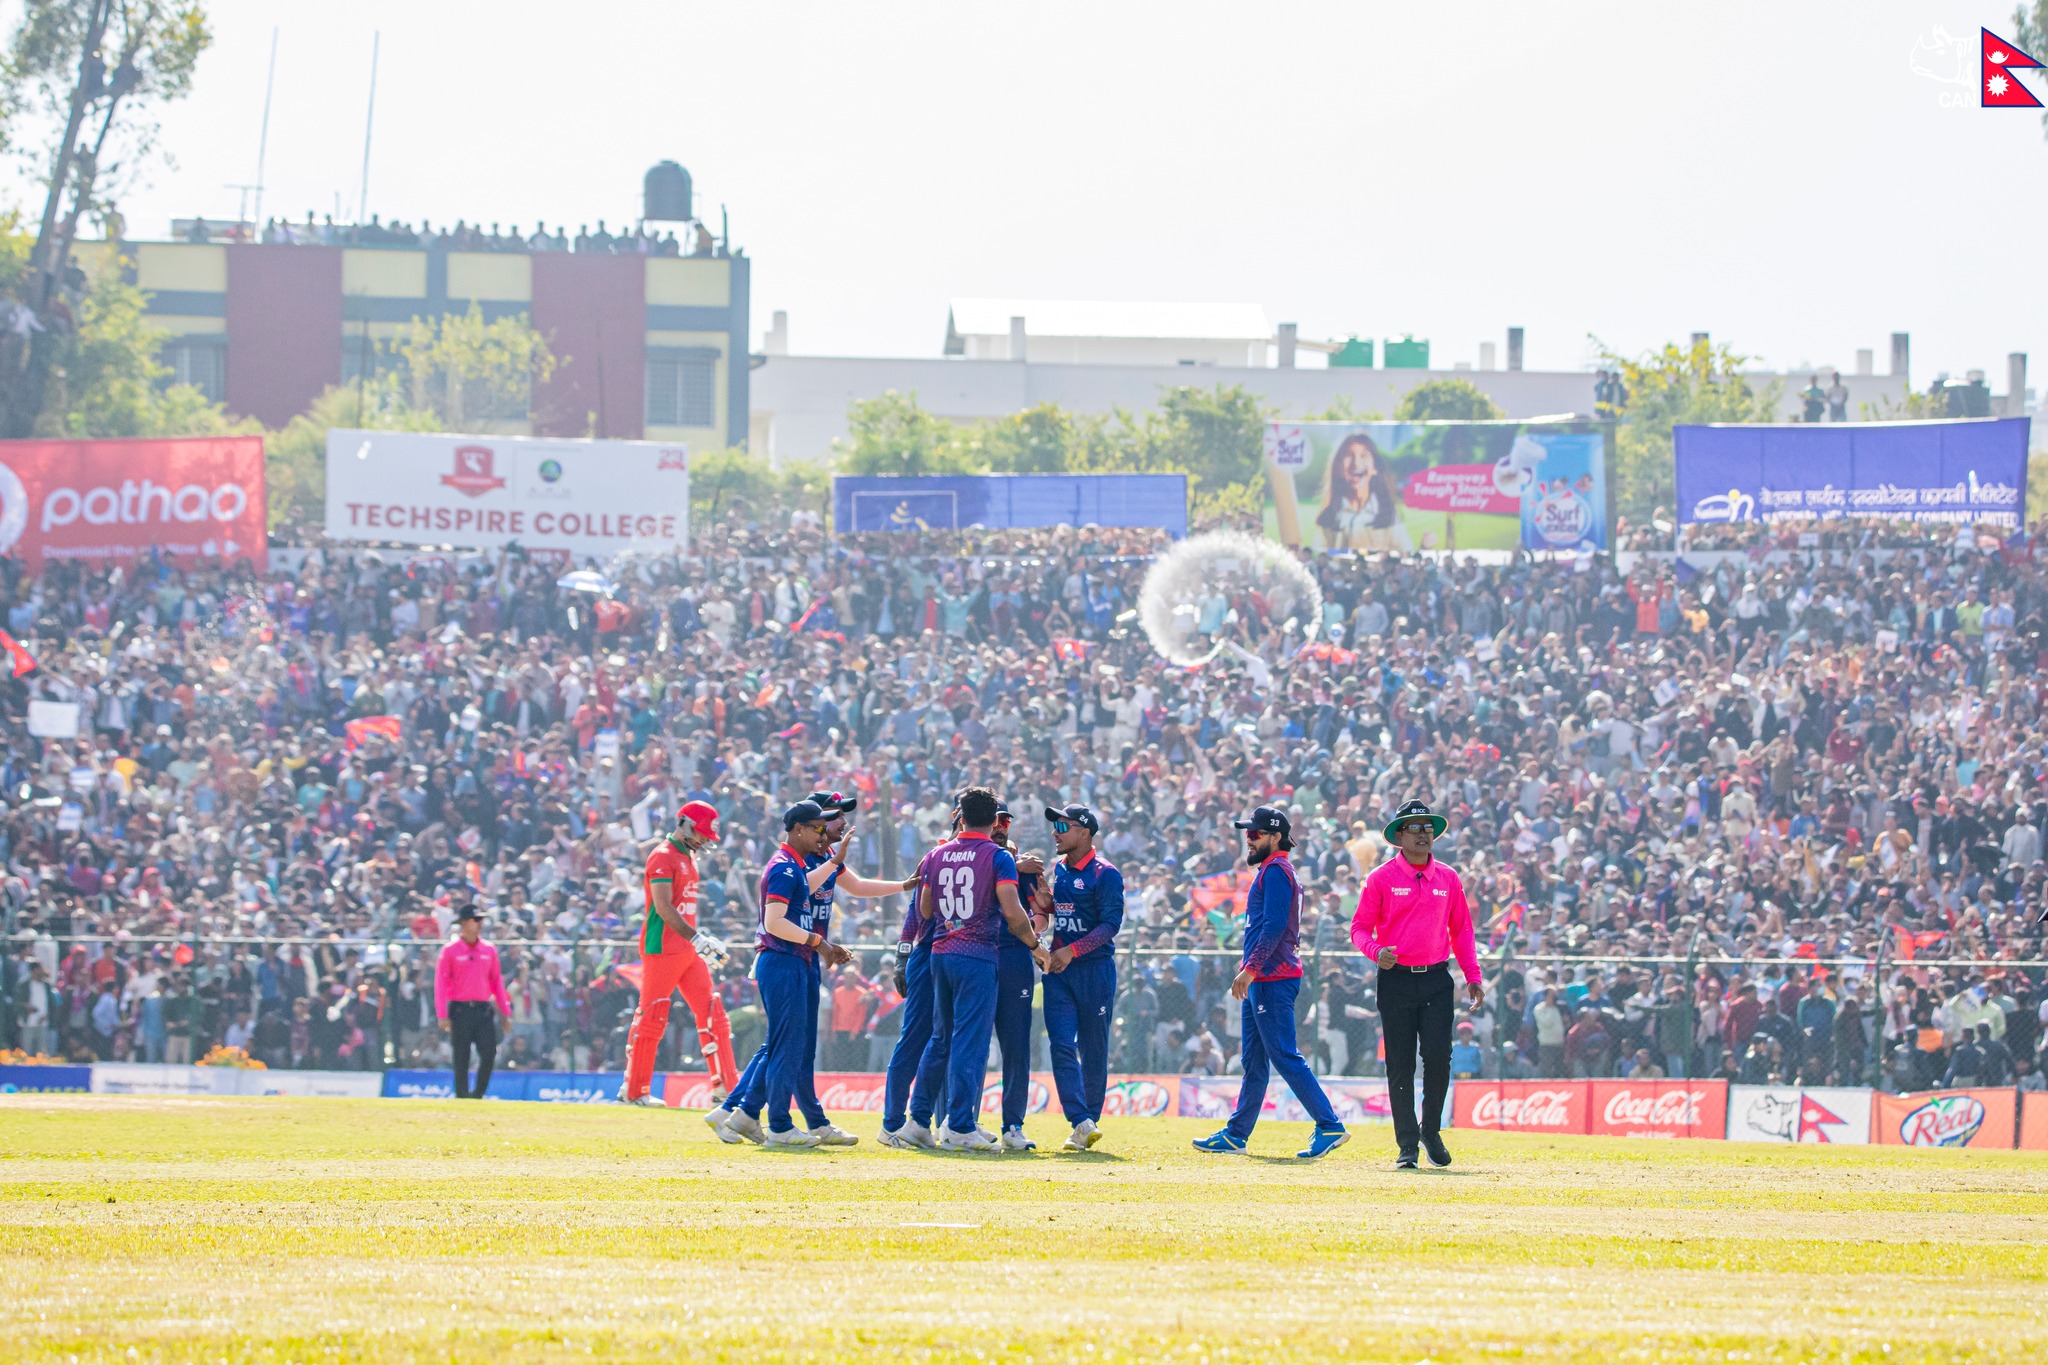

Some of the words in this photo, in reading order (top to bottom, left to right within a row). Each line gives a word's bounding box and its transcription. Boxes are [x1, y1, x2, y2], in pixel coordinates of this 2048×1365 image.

[1427, 471, 1487, 484] Removes
[1414, 482, 1454, 499] Tough
[41, 479, 248, 532] pathao
[1449, 495, 1490, 511] Easily
[1546, 503, 1579, 521] Surf
[347, 503, 524, 534] TECHSPIRE
[534, 512, 676, 539] COLLEGE
[1079, 814, 1089, 825] 24
[1270, 818, 1280, 827] 33
[942, 850, 977, 863] KARAN
[938, 866, 975, 920] 33
[1054, 917, 1088, 932] EPAL
[1471, 1090, 1574, 1127] Coca-Cola
[1603, 1090, 1707, 1126] Coca-Cola
[1909, 1099, 1975, 1146] Real
